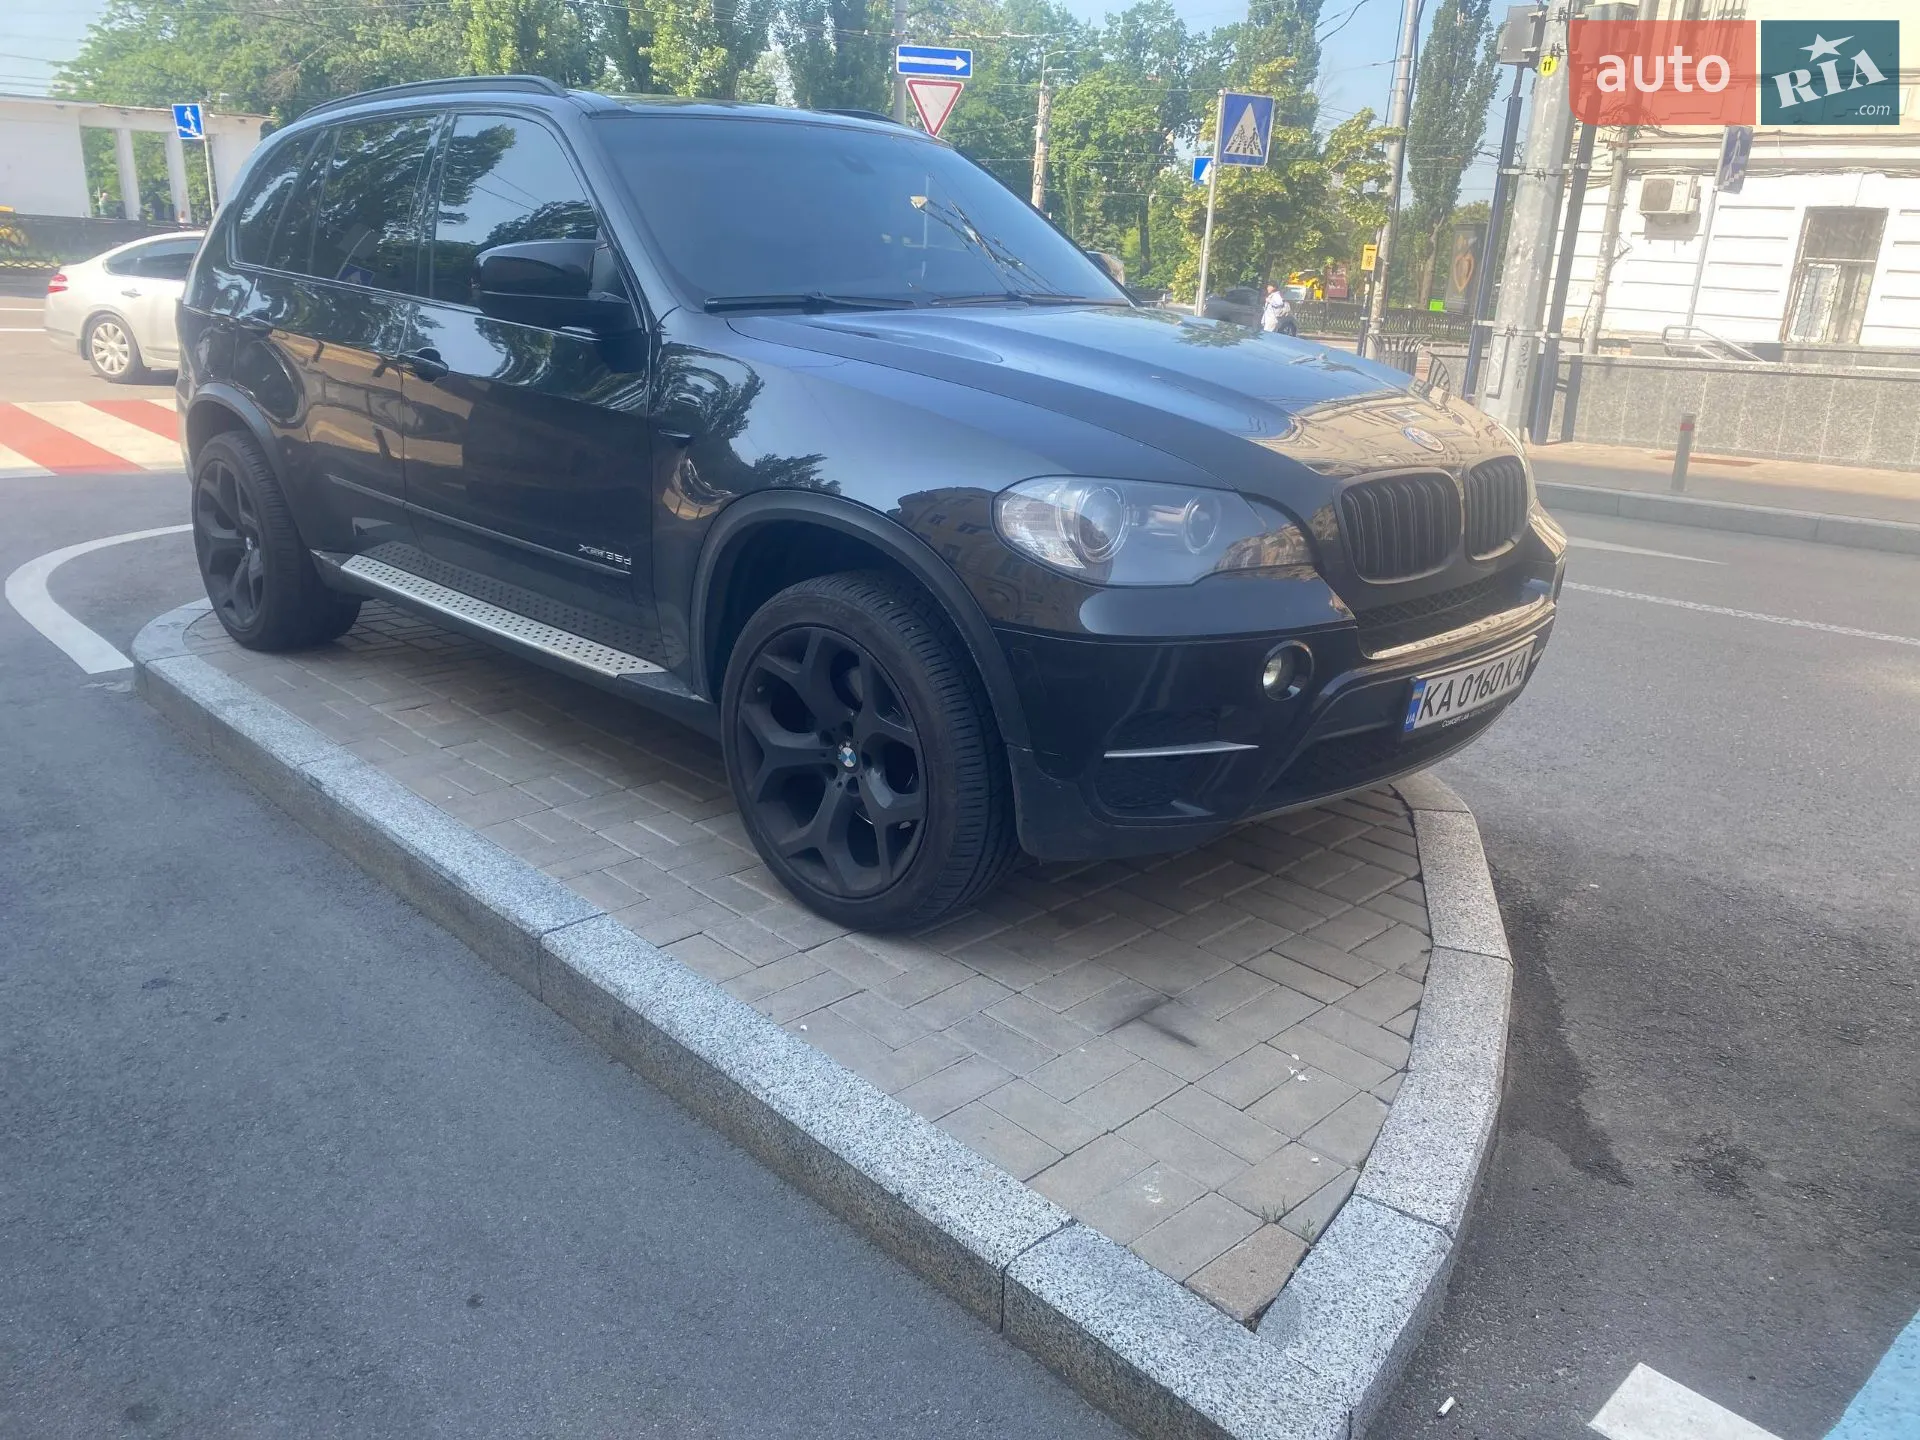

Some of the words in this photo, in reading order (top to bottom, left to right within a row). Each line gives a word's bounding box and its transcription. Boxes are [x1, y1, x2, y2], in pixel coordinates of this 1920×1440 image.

[1543, 61, 1552, 71] 11
[1419, 681, 1454, 721] KA
[1457, 661, 1505, 708] 0160
[1501, 651, 1528, 691] KA
[1405, 713, 1416, 725] UA
